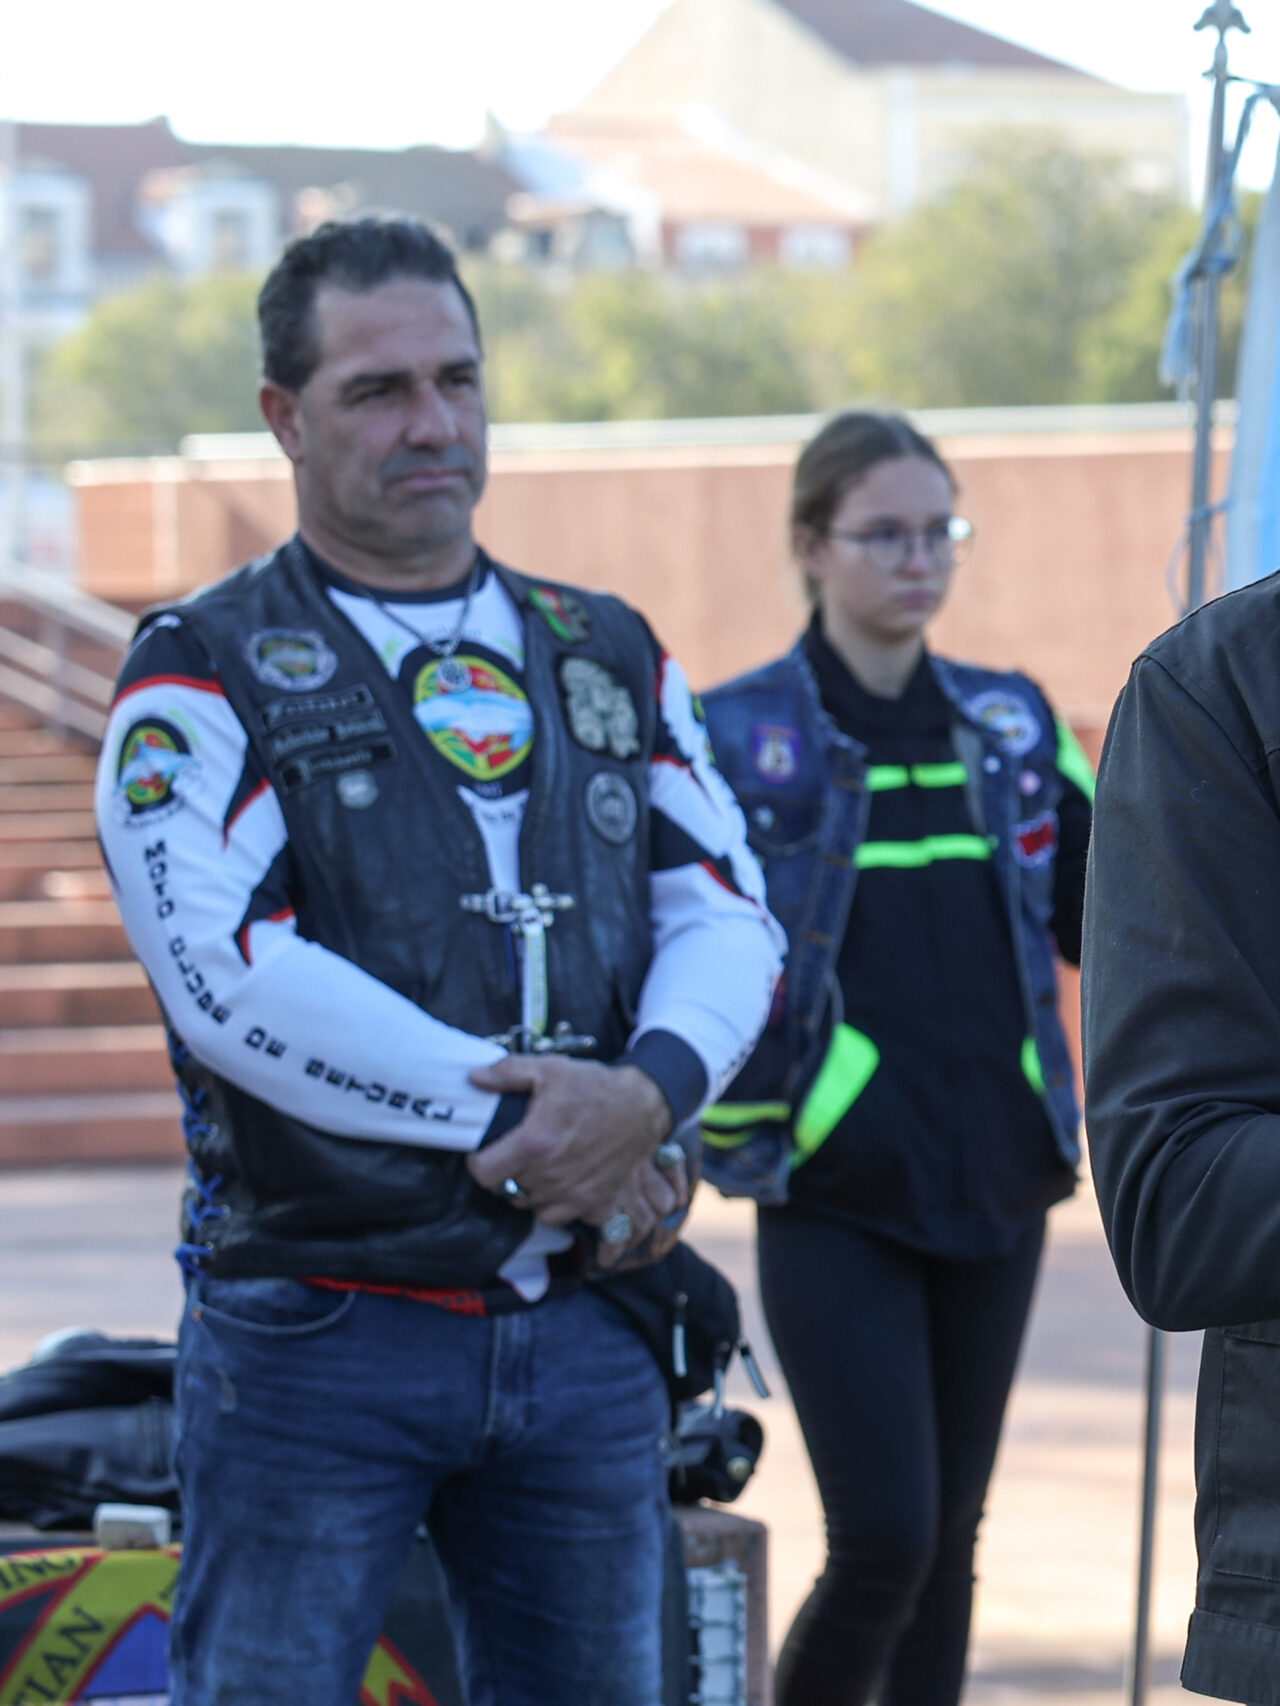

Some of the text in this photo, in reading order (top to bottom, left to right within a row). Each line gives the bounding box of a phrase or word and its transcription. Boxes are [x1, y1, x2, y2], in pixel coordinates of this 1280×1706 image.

[144, 839, 176, 920] MOTO
[169, 935, 232, 1027] CLUBE
[244, 1025, 288, 1060] DE
